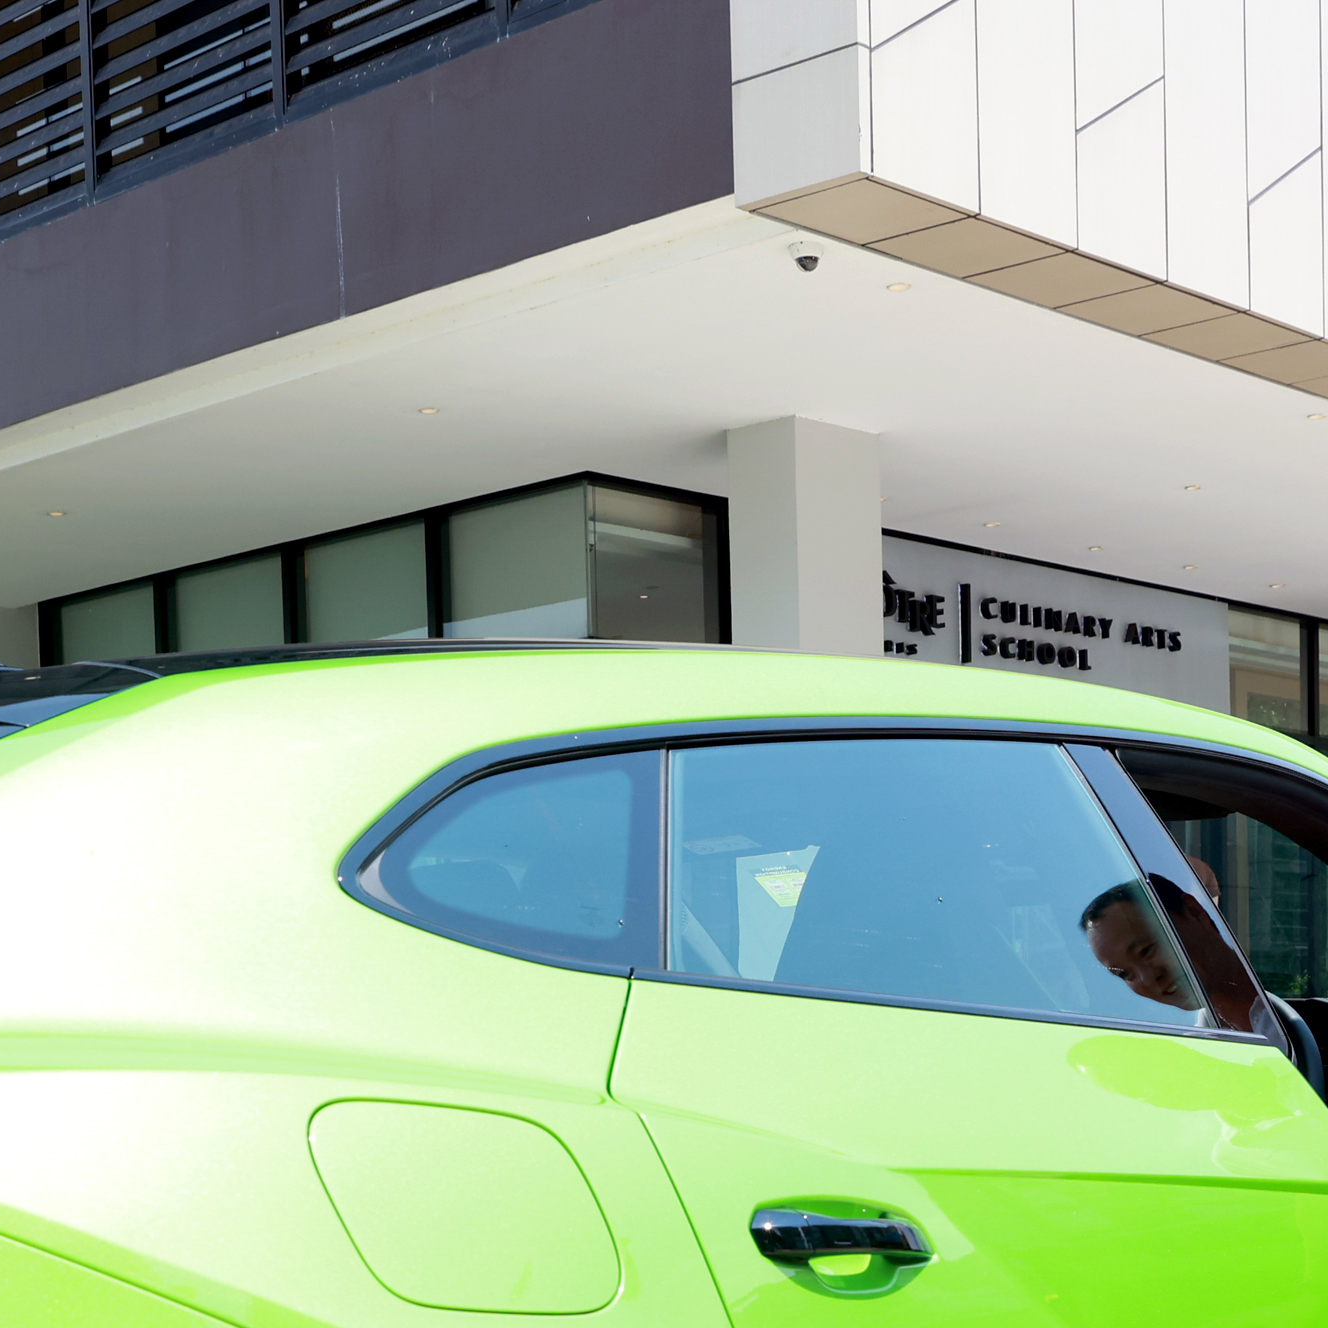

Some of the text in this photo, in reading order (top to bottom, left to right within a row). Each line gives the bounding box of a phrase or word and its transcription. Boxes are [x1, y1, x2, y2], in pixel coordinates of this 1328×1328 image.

[978, 597, 1182, 652] CULINARY ARTS
[981, 633, 1092, 671] SCHOOL
